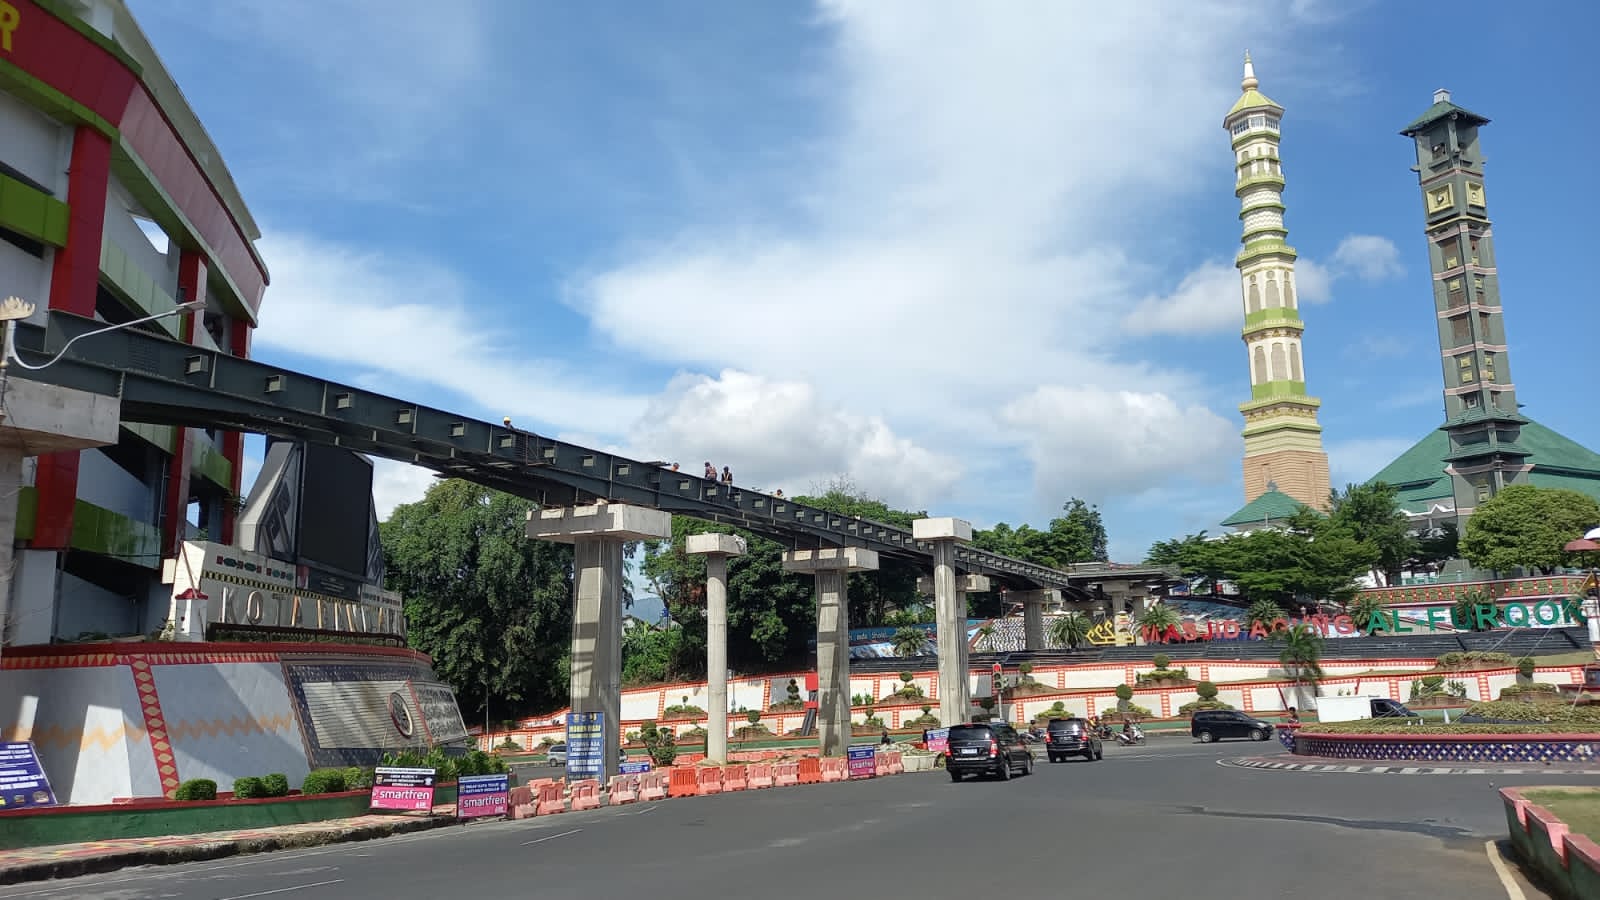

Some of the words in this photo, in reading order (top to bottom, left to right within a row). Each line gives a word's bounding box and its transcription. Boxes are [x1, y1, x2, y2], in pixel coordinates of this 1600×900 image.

[221, 587, 302, 627] KOTA
[1142, 619, 1240, 644] MASJID
[1366, 598, 1588, 634] AL-FURQON
[379, 789, 430, 800] smartfren
[463, 795, 506, 808] smartfren
